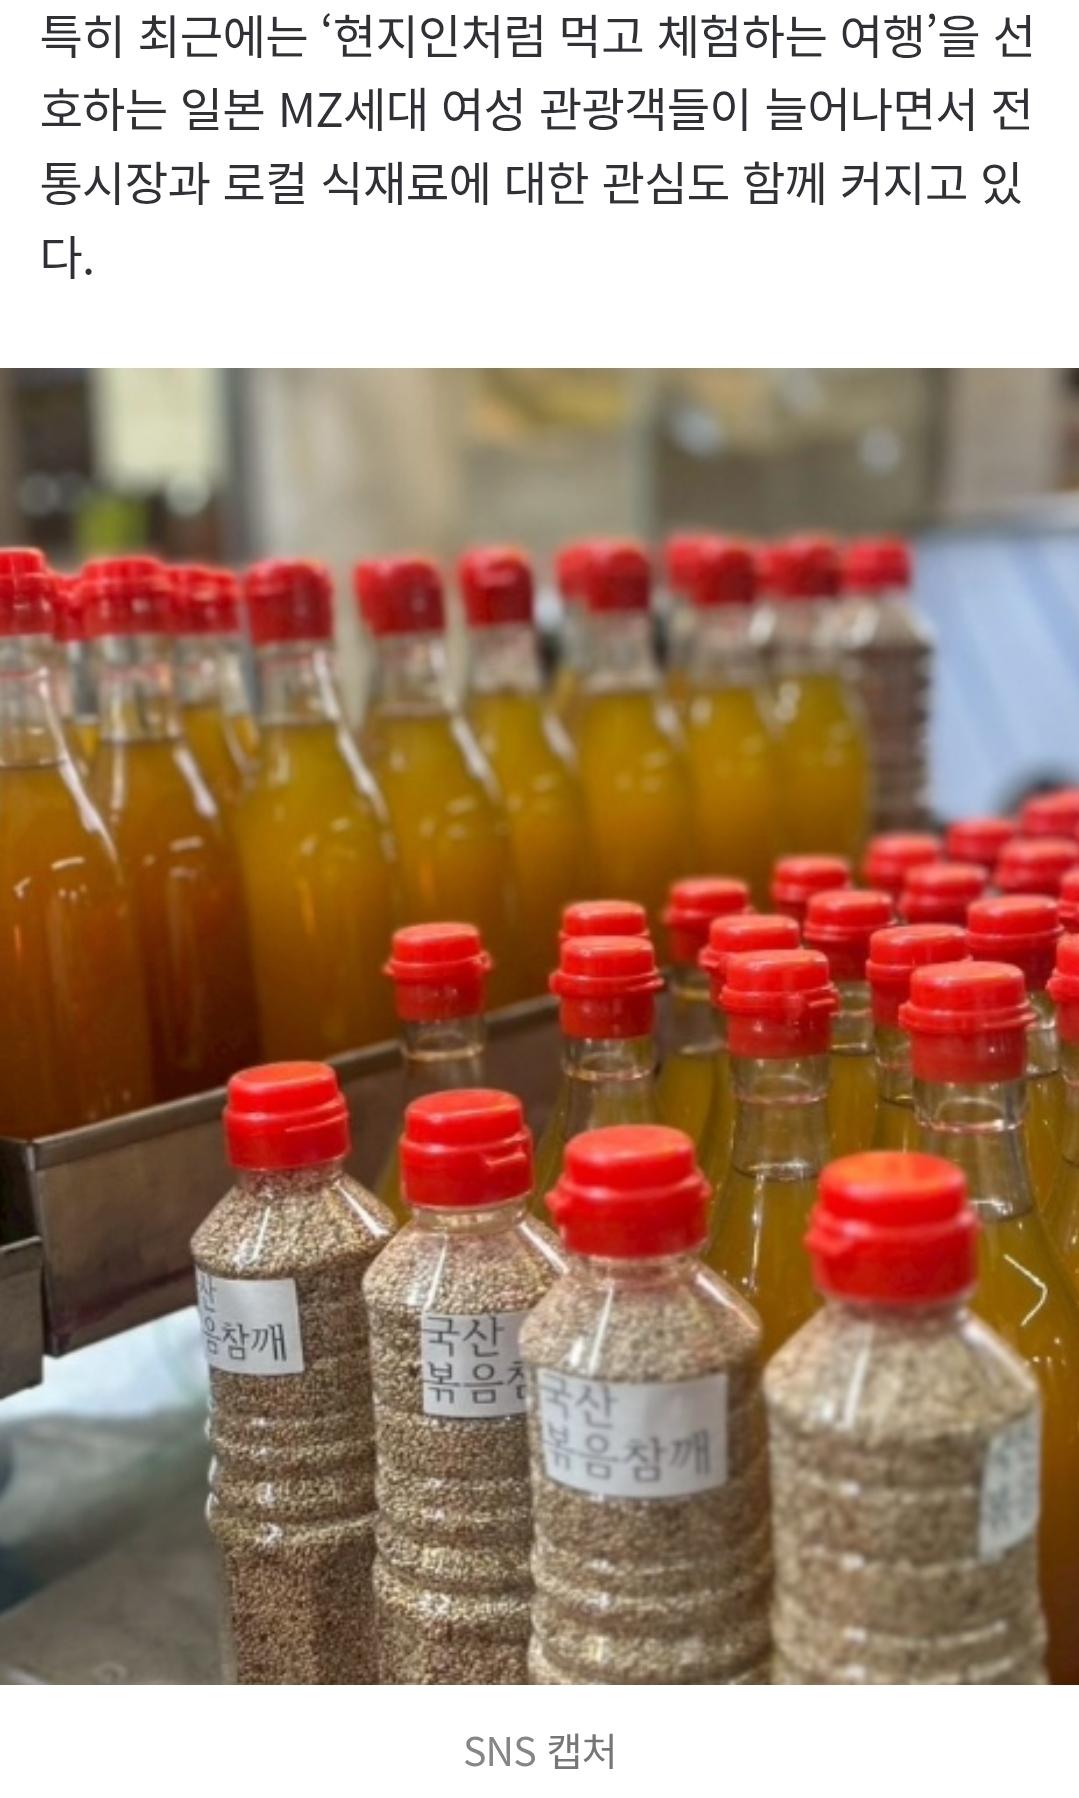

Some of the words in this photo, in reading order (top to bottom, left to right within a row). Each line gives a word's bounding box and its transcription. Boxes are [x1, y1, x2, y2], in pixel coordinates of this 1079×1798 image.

[200, 1274, 217, 1313] 산
[203, 1316, 287, 1362] 음참깨
[422, 1315, 504, 1358] 국산
[541, 1374, 618, 1429] 국산
[545, 1424, 711, 1483] 볶음참깨
